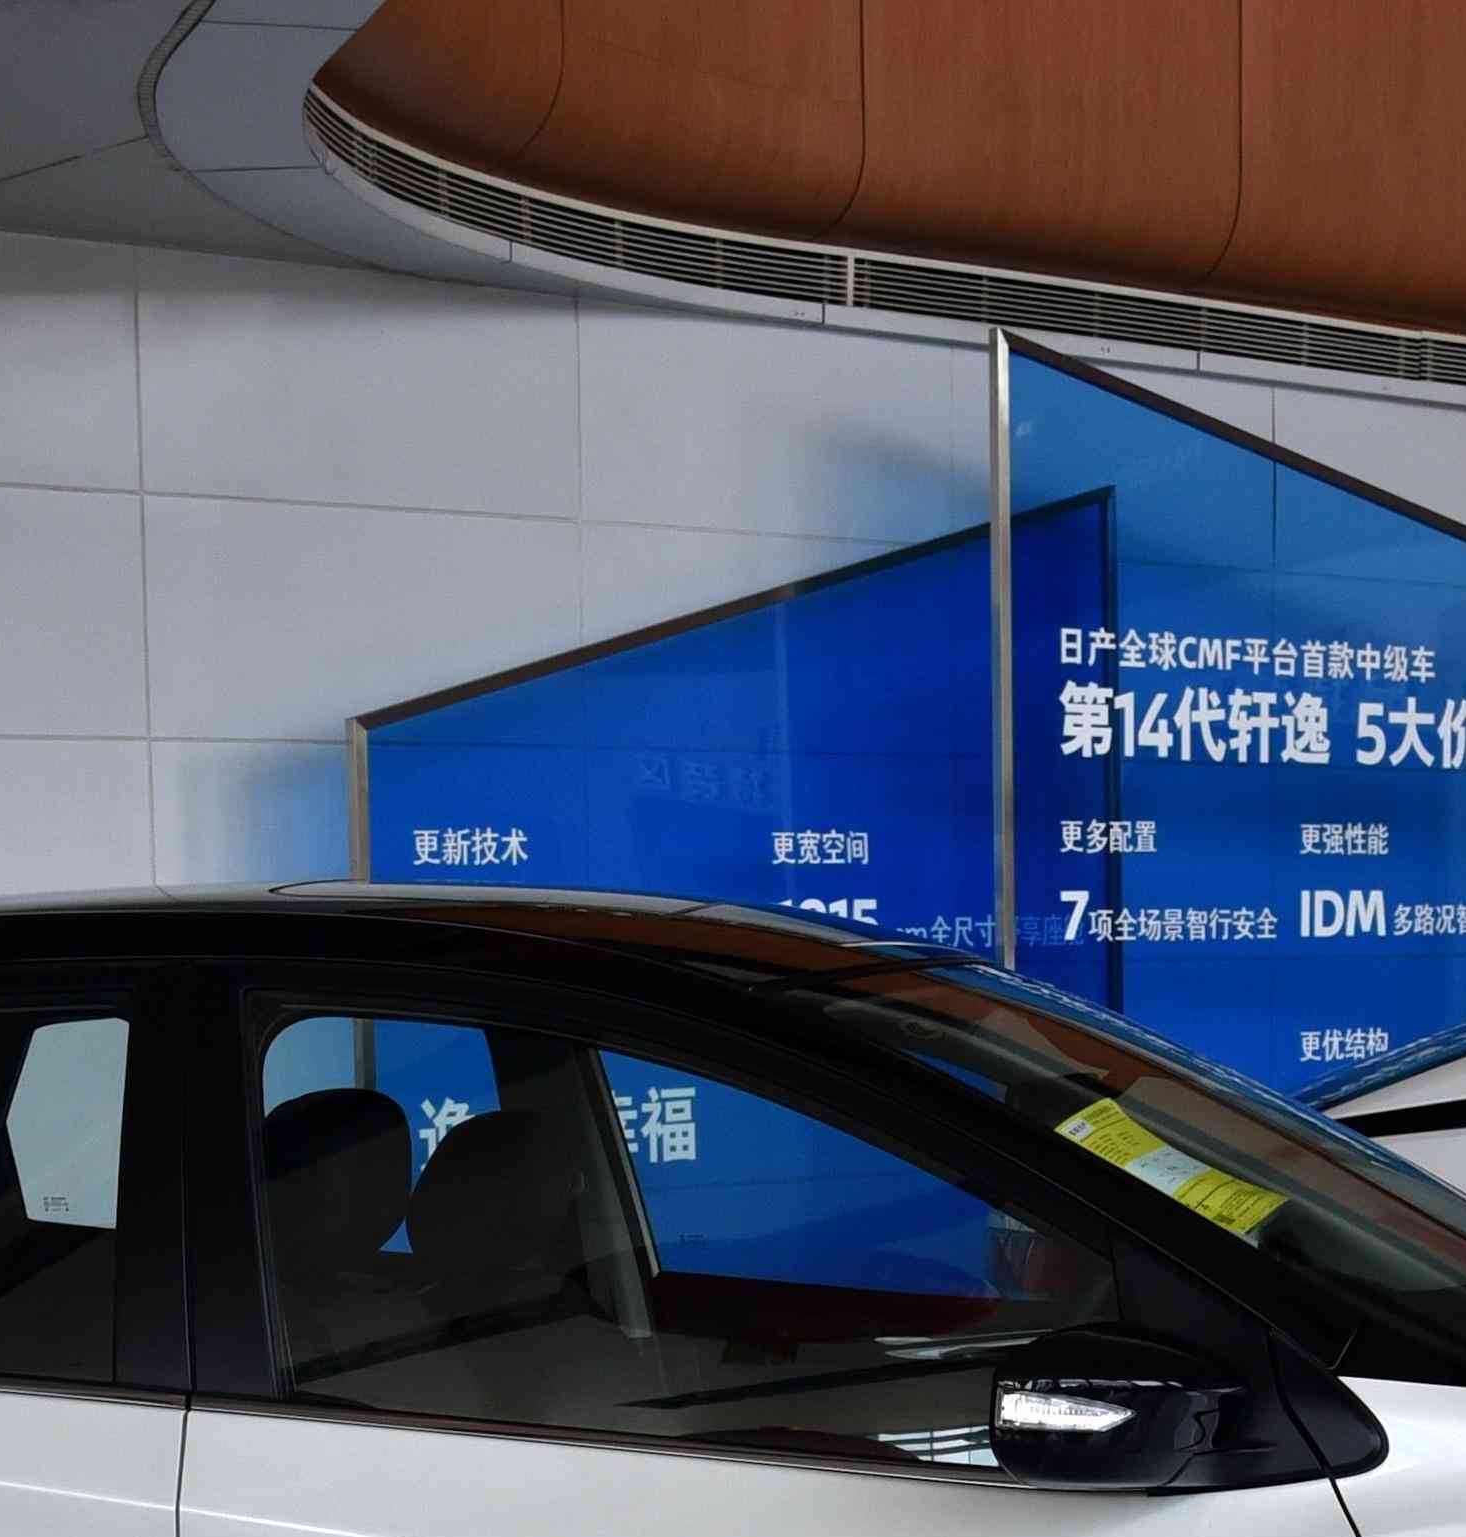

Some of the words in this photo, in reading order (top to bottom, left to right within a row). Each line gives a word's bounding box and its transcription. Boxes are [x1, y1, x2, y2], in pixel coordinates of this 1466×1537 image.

[1059, 627, 1436, 683] 日产全球CMF平台首款中级车
[1059, 680, 1332, 764] 第14代轩逸
[413, 827, 529, 866] 更新技术
[772, 829, 870, 865] 更宽空间
[1060, 818, 1157, 853] 更多配置
[1299, 822, 1389, 856] 更强性能
[1300, 890, 1386, 937] IDM
[1299, 1027, 1389, 1062] 更优结构
